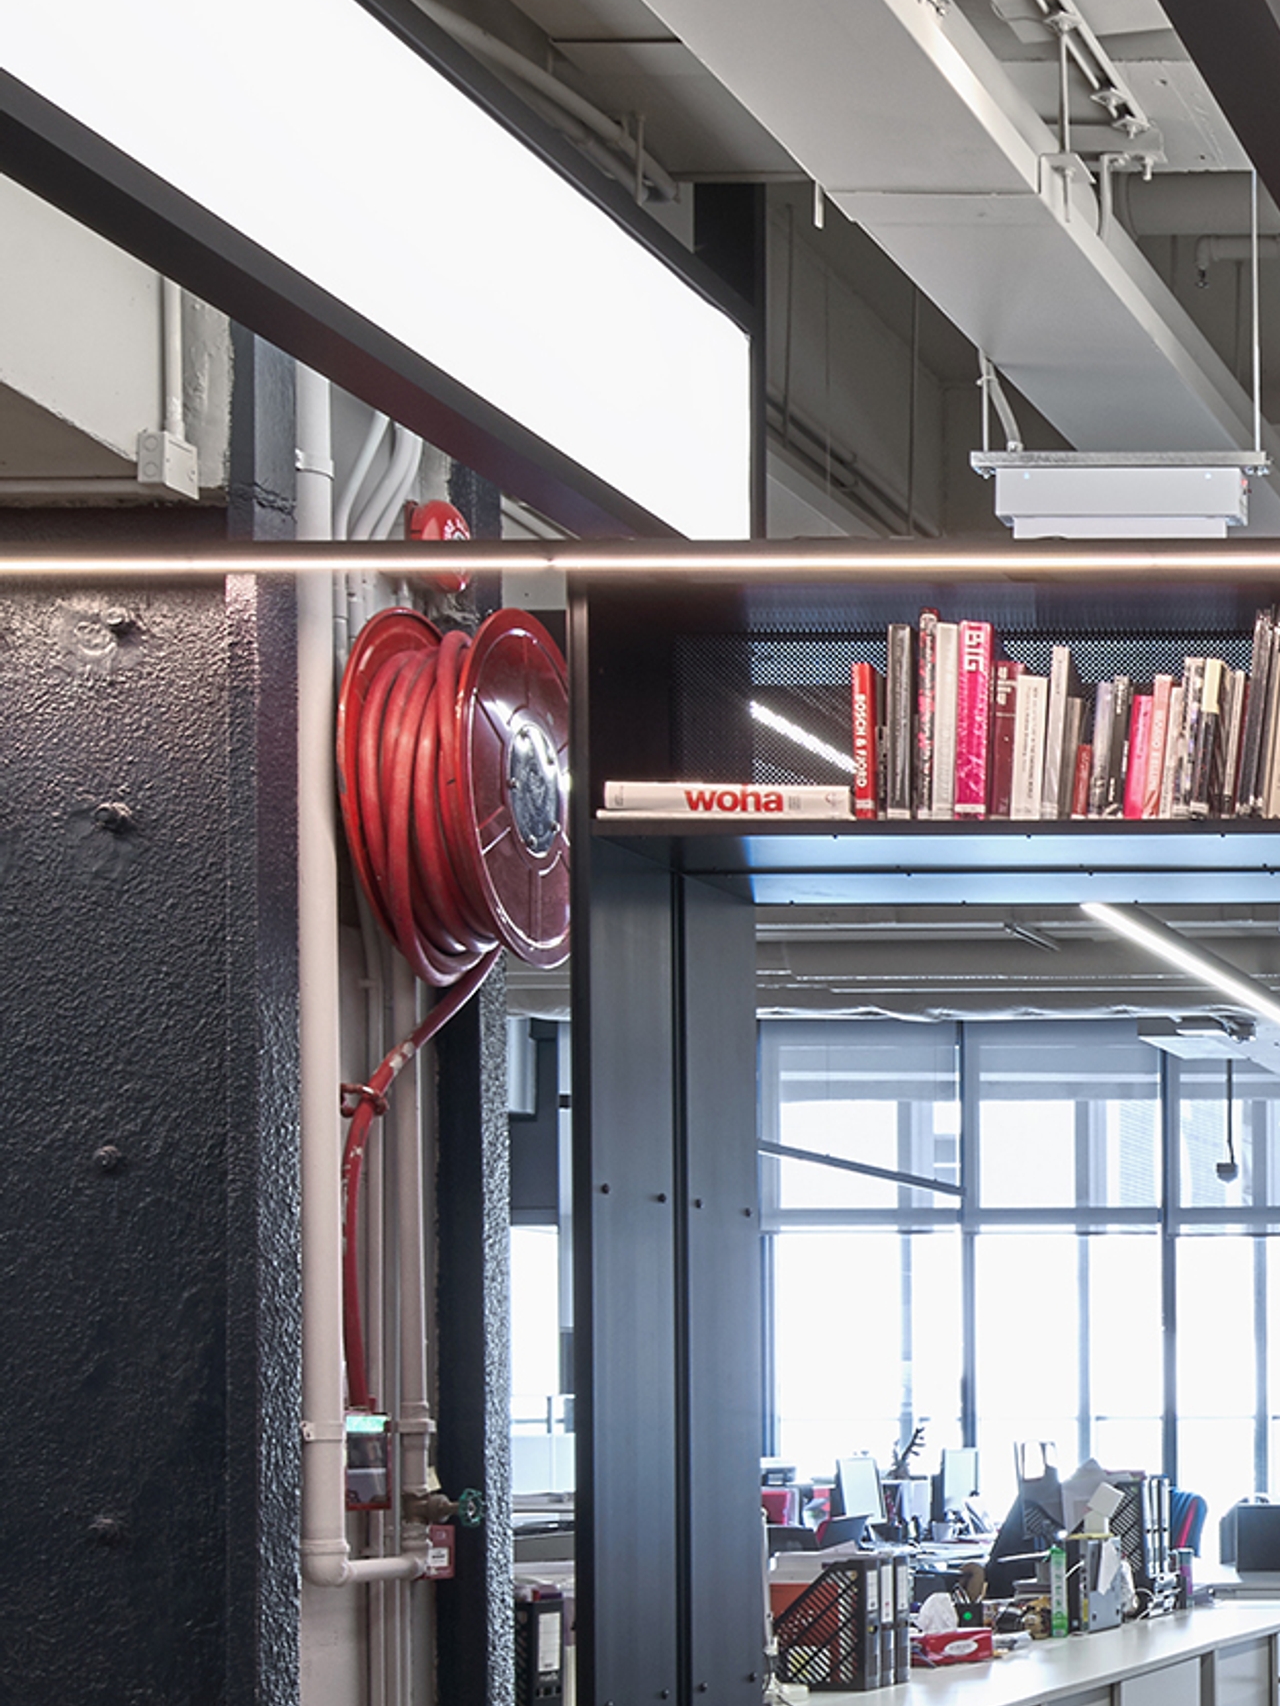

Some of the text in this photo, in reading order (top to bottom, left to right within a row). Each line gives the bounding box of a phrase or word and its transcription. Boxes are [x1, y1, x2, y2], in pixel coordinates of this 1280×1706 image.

[964, 629, 986, 674] BIG
[854, 693, 868, 788] BOSCH & FJORD
[684, 783, 784, 813] woha
